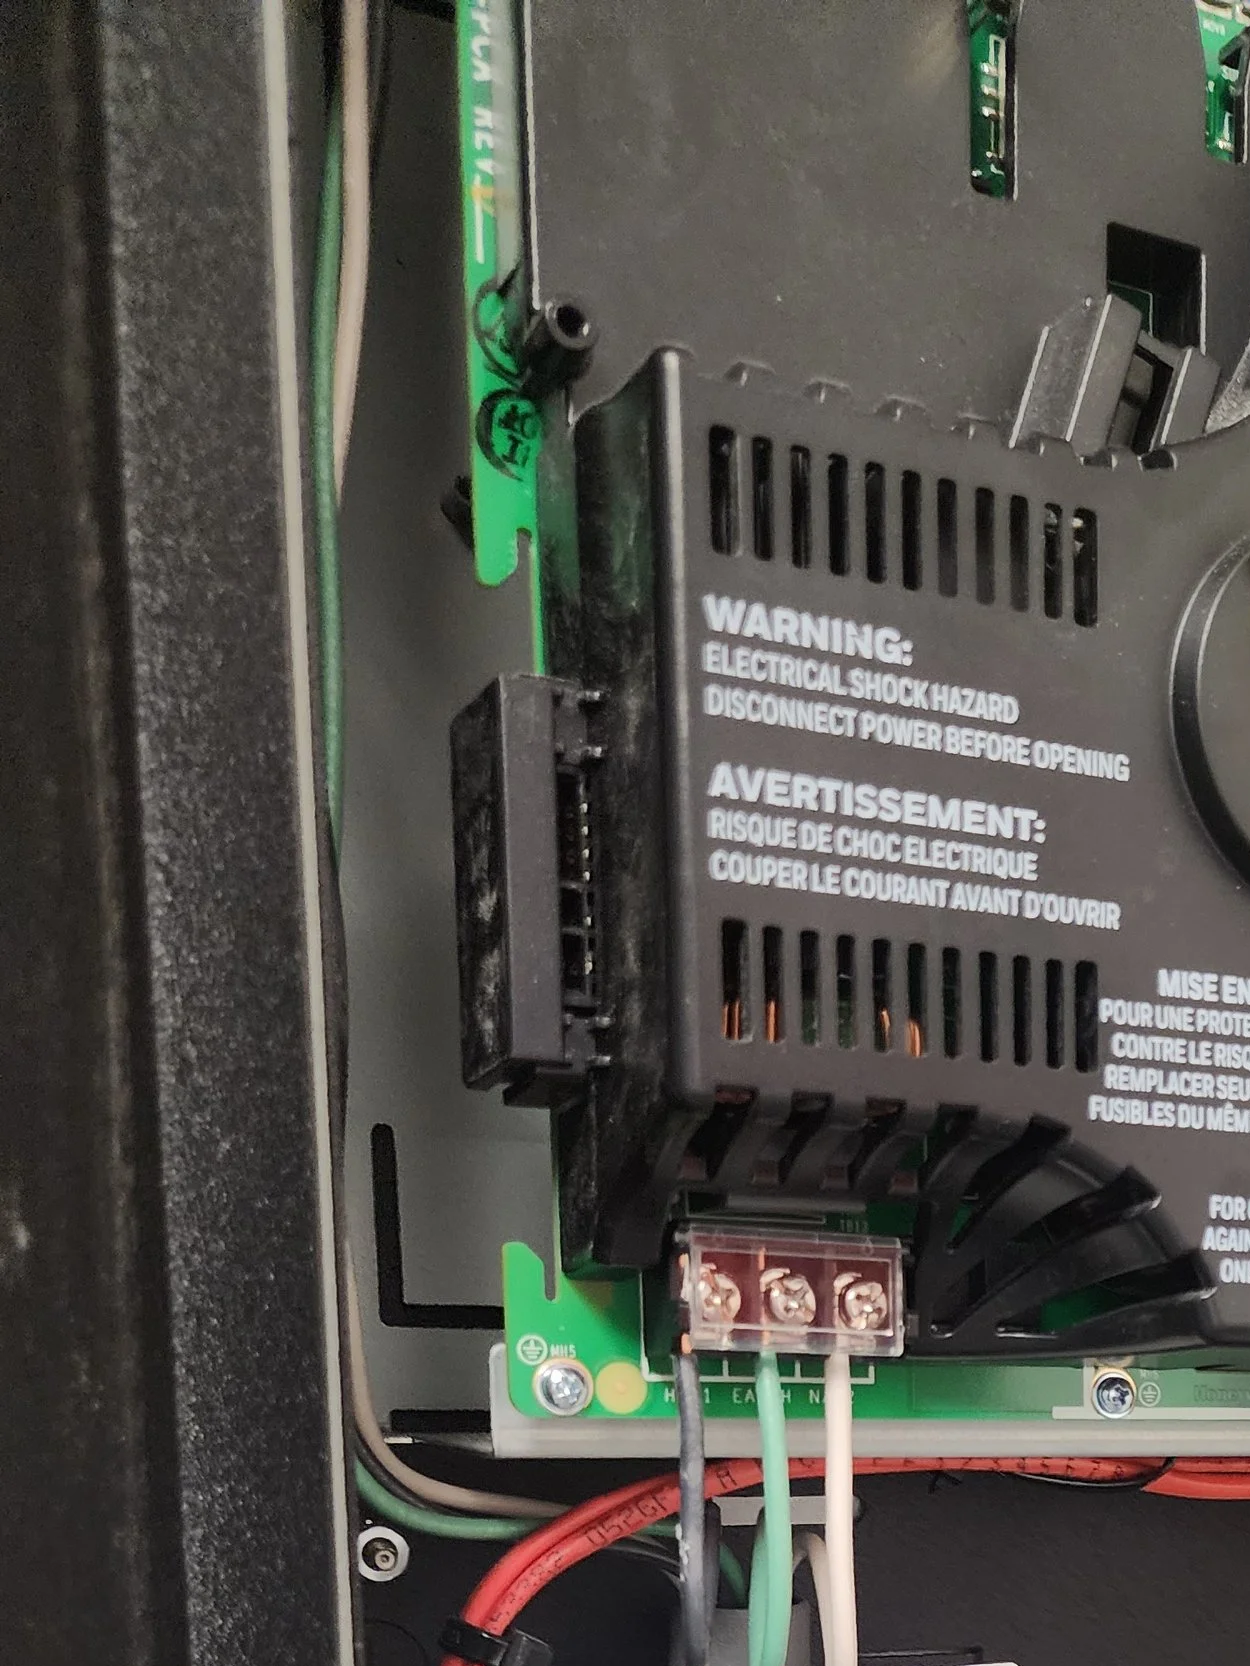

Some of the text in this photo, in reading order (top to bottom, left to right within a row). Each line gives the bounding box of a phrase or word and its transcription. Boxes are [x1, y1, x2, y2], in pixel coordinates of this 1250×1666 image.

[702, 594, 913, 666] WARNING:
[703, 641, 1019, 724] ELECTRICAL SHOCK HAZARD
[704, 685, 1130, 782] DISCONNECT POWER BEFORE OPENING
[708, 762, 1046, 844] AVERTISSEMENT:
[708, 807, 1038, 881] RISQUE DE CHOC ELECTRIQUE
[709, 849, 1121, 930] COUPER LE COURANT AVANT D'OUVRIR
[1157, 968, 1218, 1000] MISE
[1101, 999, 1154, 1029] POUR
[1155, 1003, 1193, 1032] UNE
[1112, 1032, 1186, 1064] CONTRE
[1189, 1040, 1213, 1067] LE
[1105, 1064, 1215, 1098] REMPLACER
[1089, 1095, 1175, 1128] FUSIBLES
[1177, 1103, 1205, 1130] DU
[1209, 1195, 1246, 1221] FOR
